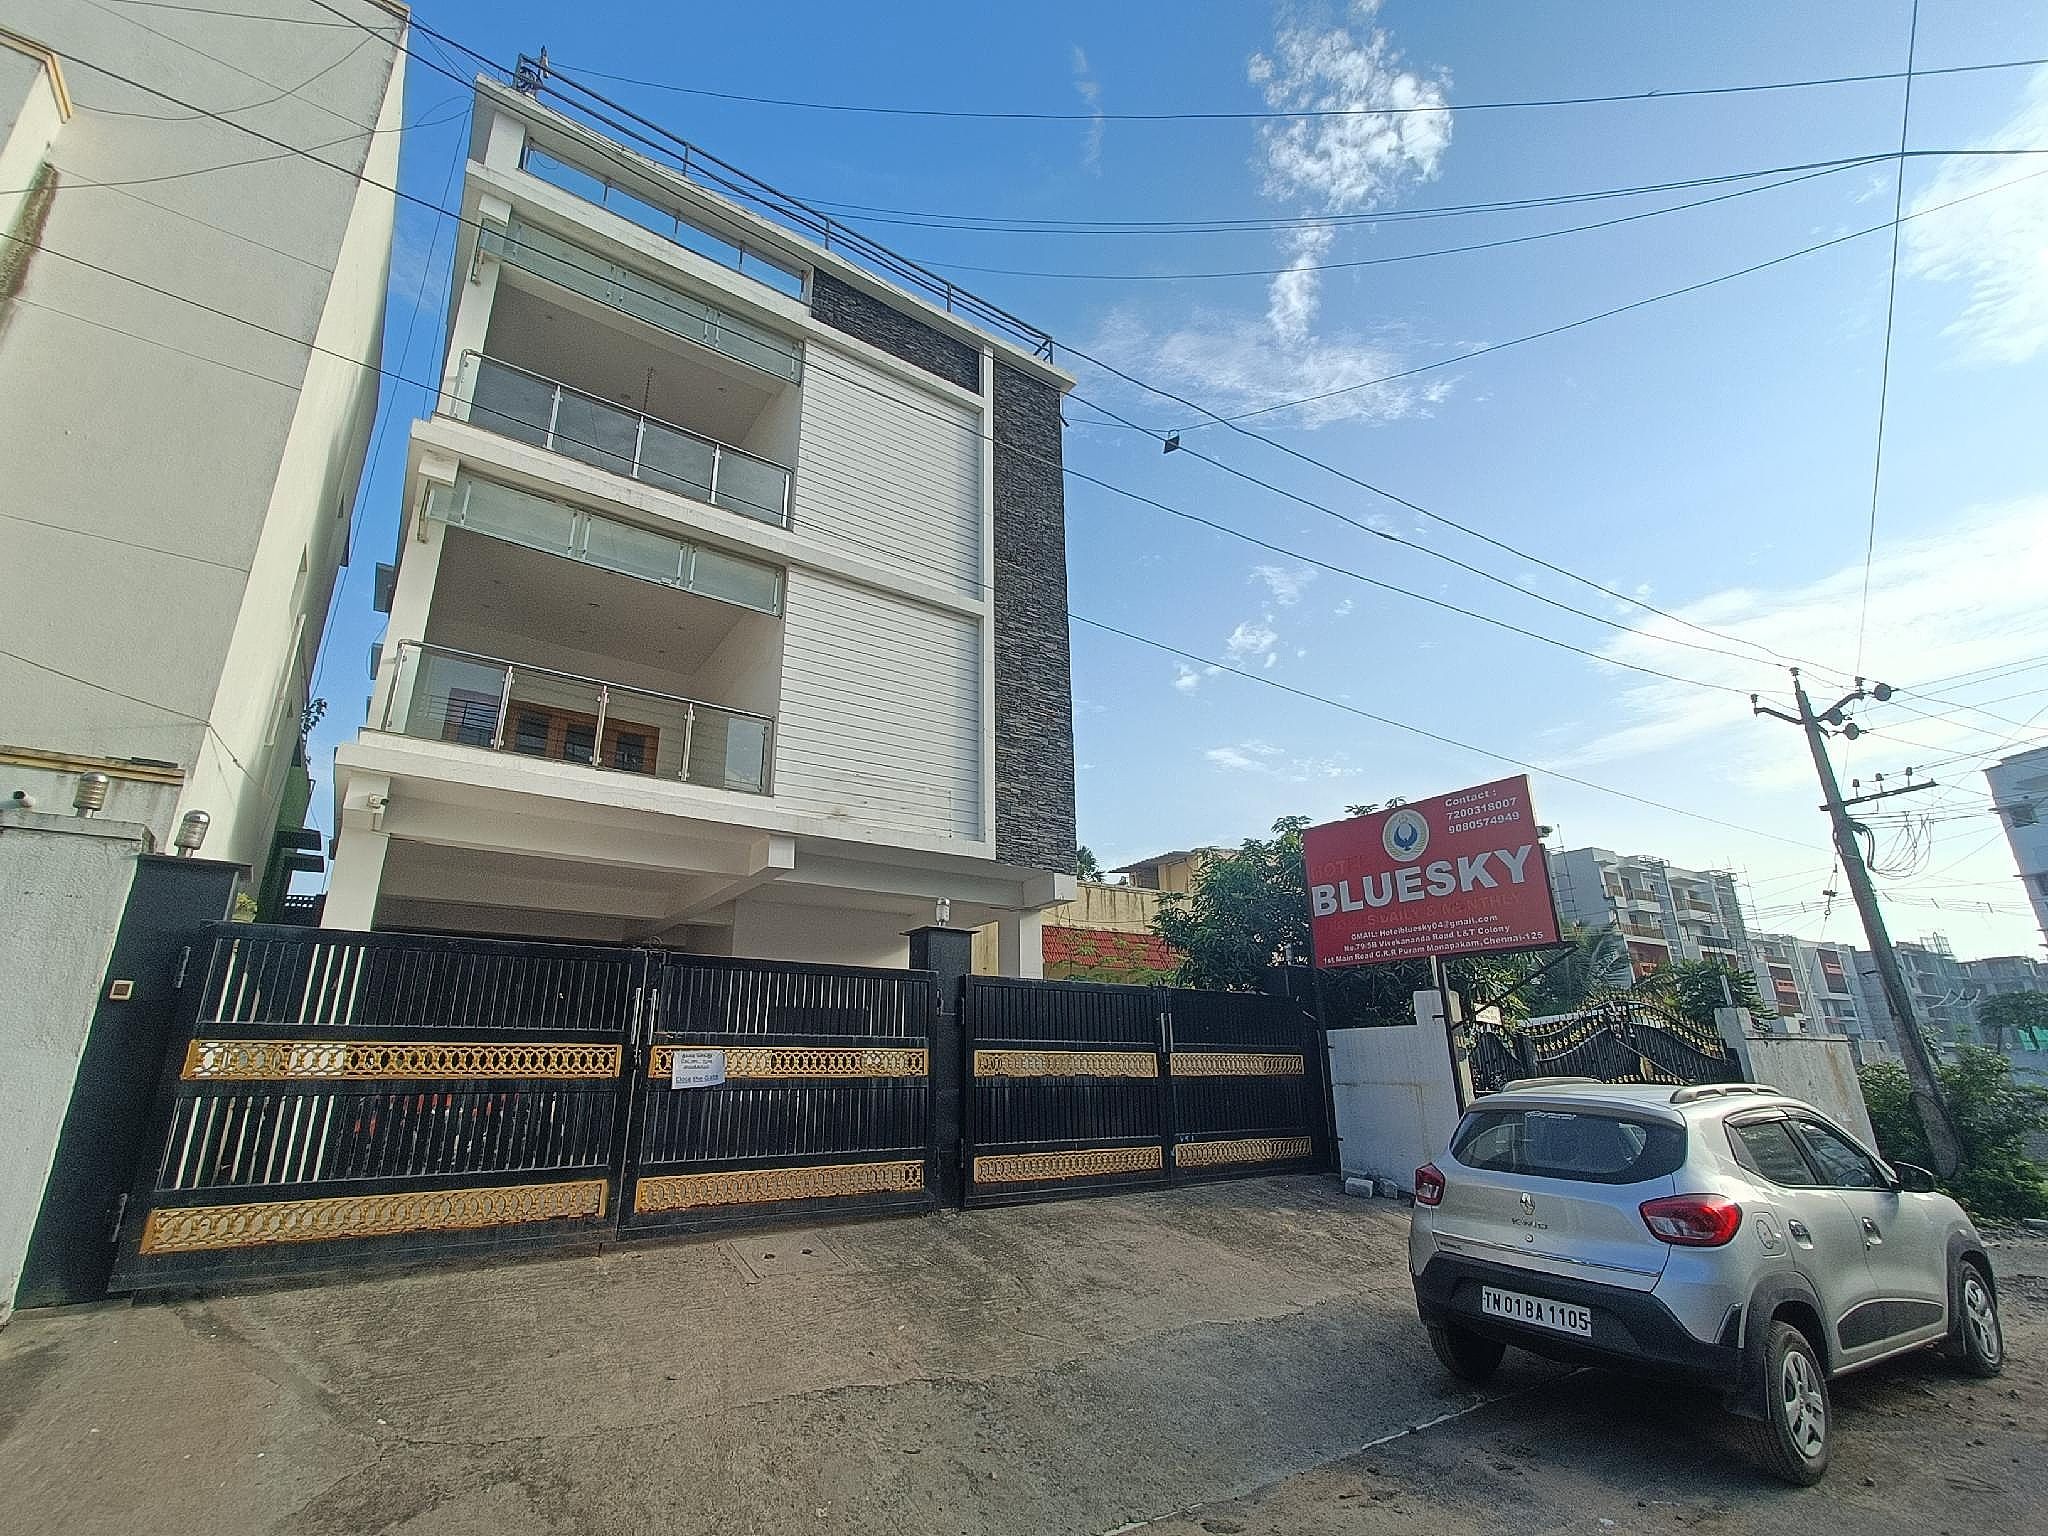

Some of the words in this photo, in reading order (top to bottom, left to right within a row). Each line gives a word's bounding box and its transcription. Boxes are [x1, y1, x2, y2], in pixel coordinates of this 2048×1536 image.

[1445, 790, 1489, 807] Contact
[1446, 797, 1517, 820] 7200318007
[1448, 811, 1520, 834] 9080574949
[1312, 845, 1532, 917] BLUESKY
[1432, 929, 1454, 941] Road
[1457, 928, 1475, 938] L&T
[1478, 924, 1511, 935] Colony
[1335, 953, 1353, 963] Main
[1354, 951, 1374, 961] Road
[1398, 945, 1425, 955] Puram
[1485, 1291, 1500, 1311] TN
[1549, 1305, 1588, 1331] 1105
